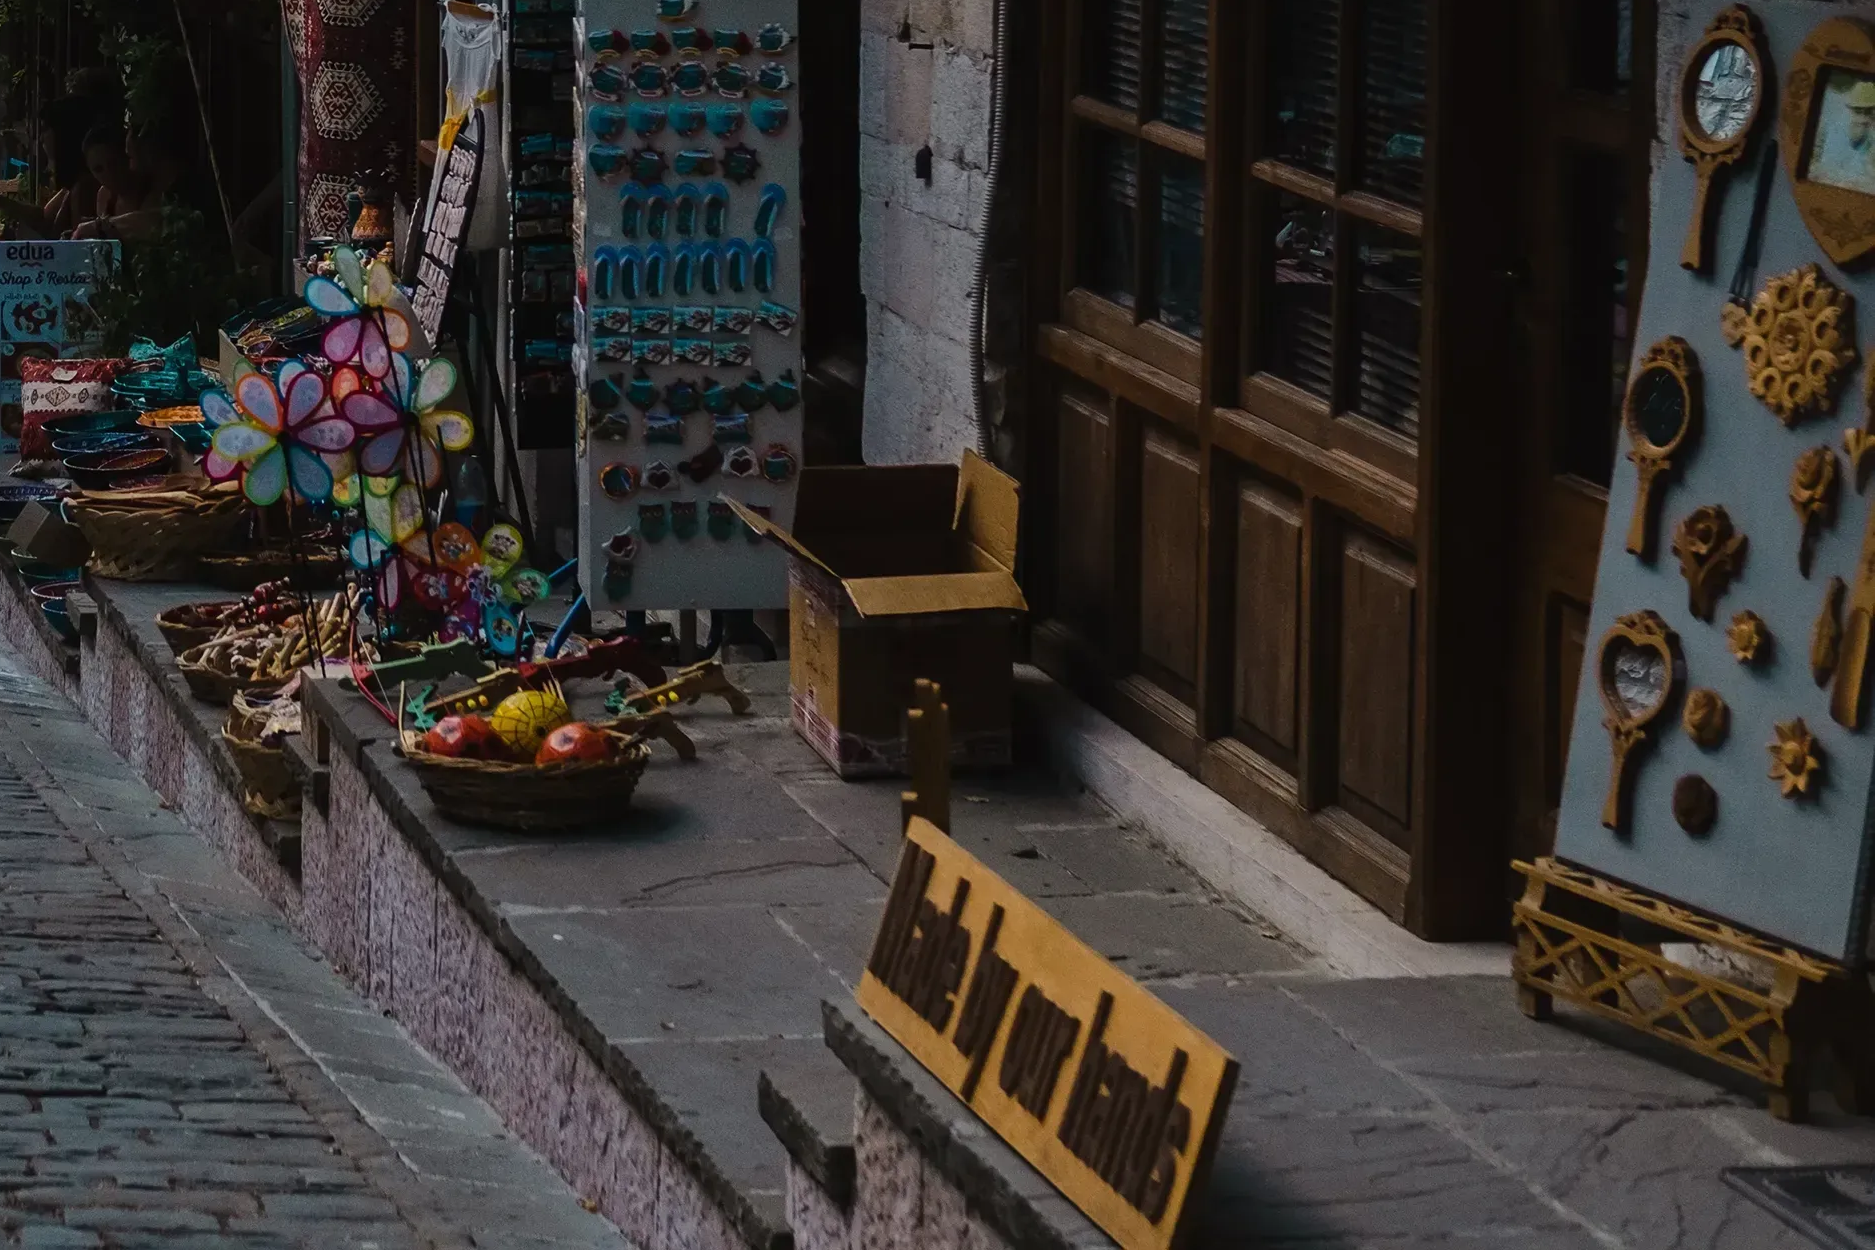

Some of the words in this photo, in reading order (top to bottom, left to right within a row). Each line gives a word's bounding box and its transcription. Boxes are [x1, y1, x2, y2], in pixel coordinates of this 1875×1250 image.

[6, 241, 55, 260] edua
[0, 271, 32, 291] Shop
[867, 837, 973, 1033] Made
[953, 904, 1020, 1102] by
[1000, 985, 1082, 1122] our
[1058, 992, 1192, 1225] hands
